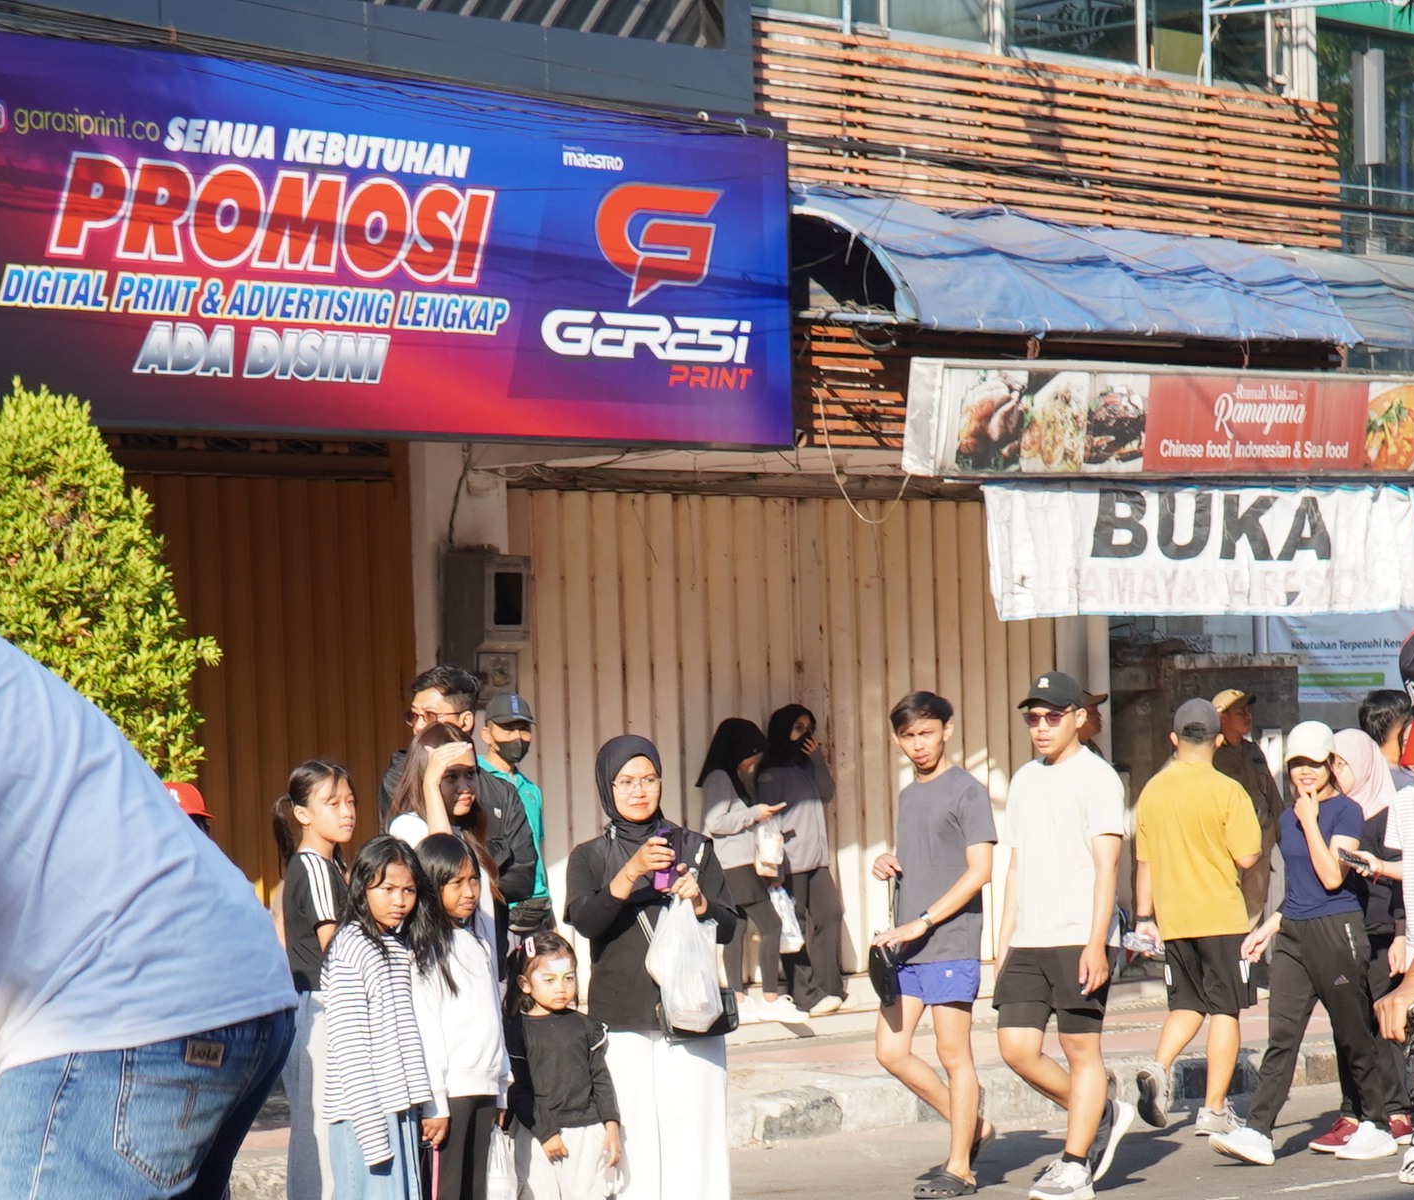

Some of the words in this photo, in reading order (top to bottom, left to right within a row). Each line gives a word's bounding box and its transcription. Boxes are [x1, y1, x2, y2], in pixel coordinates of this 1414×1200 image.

[14, 108, 161, 141] garasiprint.co
[163, 116, 275, 160] SEMUA
[283, 127, 471, 179] KEBUTUHAN
[46, 151, 496, 284] PROMOSI
[110, 272, 201, 317] PRINT
[198, 276, 225, 319] &
[224, 279, 395, 328] ADVERTISING
[394, 290, 510, 336] LENGKAP
[133, 320, 235, 378] ADA
[242, 326, 391, 385] DISINI
[668, 365, 753, 390] PRINT
[1213, 392, 1308, 440] Ramayana
[1159, 438, 1205, 458] Chinese
[1234, 440, 1291, 459] Indonesian
[1292, 441, 1302, 458] &
[1303, 440, 1324, 459] Sea
[1325, 441, 1350, 459] food
[1089, 488, 1332, 561] BUKA
[1338, 638, 1381, 651] Terpenuhi
